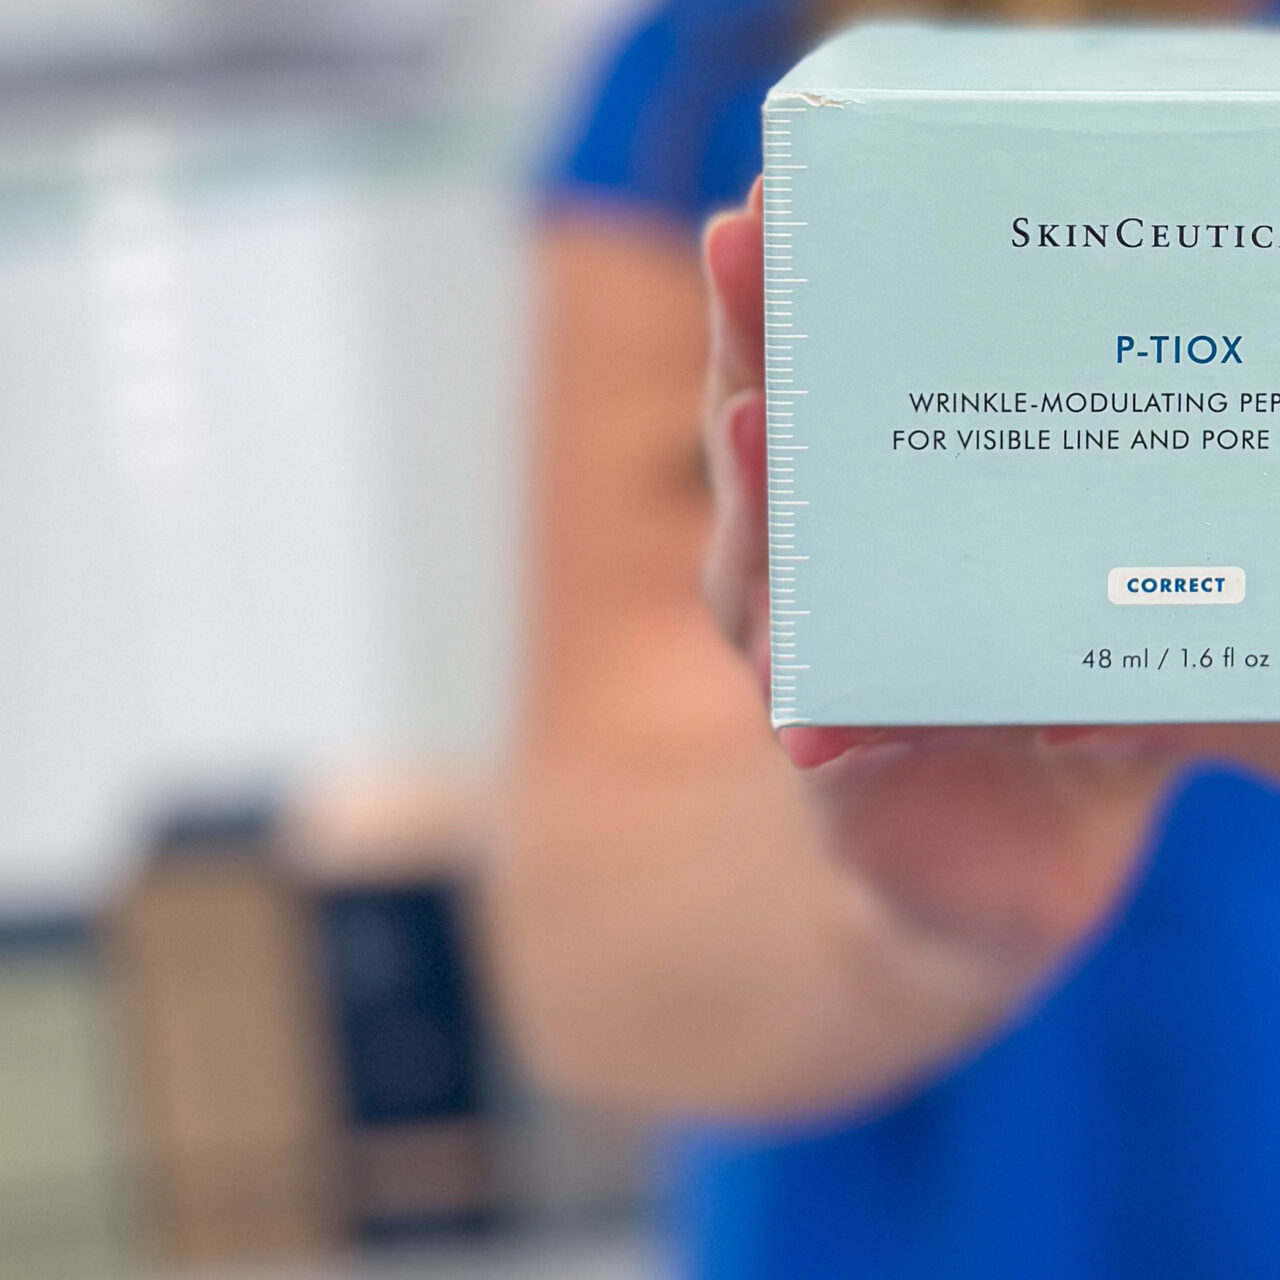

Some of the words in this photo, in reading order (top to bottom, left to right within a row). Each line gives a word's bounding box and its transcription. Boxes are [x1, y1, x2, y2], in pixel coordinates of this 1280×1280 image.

[1116, 335, 1244, 365] P-TIOX
[908, 392, 1228, 414] WRINKLE-MODULATING
[892, 429, 948, 451] FOR
[956, 429, 1051, 451] VISIBLE
[1063, 429, 1120, 450] LINE
[1130, 429, 1190, 450] AND
[1202, 429, 1270, 450] PORE
[1126, 576, 1226, 593] CORRECT
[1081, 648, 1112, 669] 48
[1122, 647, 1149, 669] ml
[1157, 647, 1170, 671] /
[1180, 647, 1213, 669] 1.6
[1222, 646, 1235, 668] fl
[1244, 654, 1270, 668] oz
